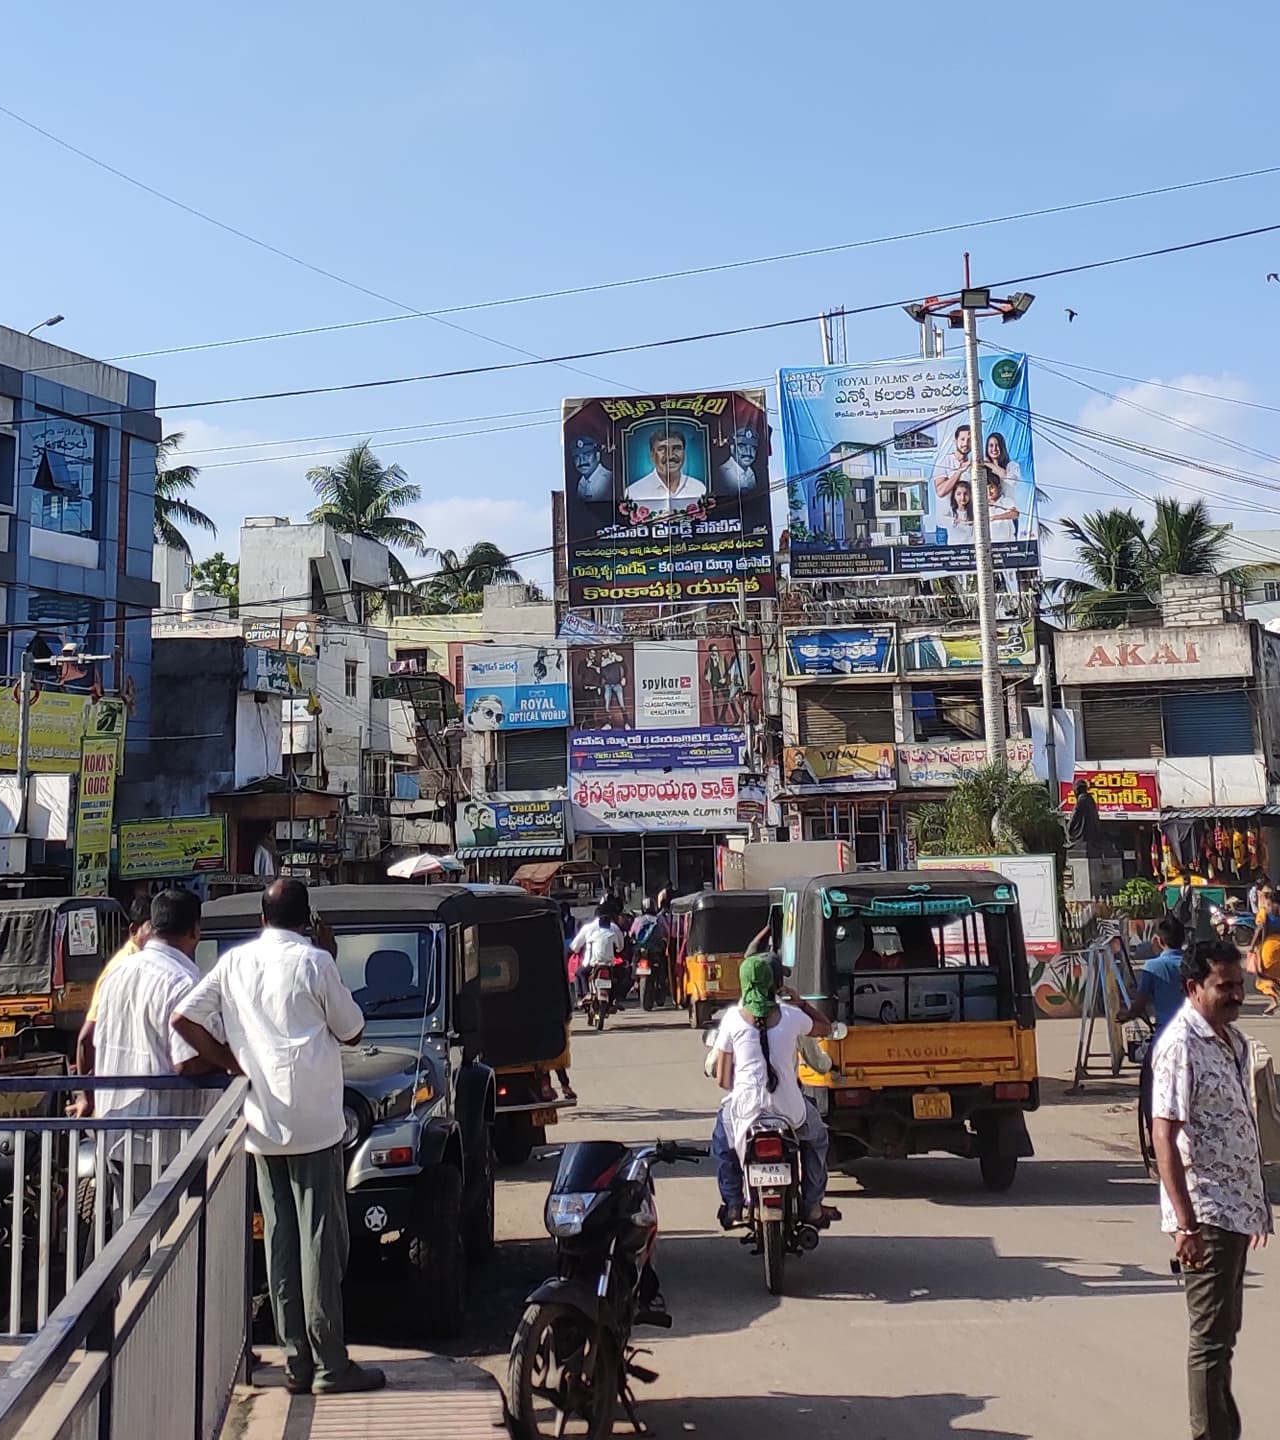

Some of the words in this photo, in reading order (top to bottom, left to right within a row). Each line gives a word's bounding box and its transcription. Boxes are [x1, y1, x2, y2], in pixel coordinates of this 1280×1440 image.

[835, 388, 871, 408] ఎన్నో
[875, 386, 916, 402] కలలకి
[1085, 641, 1201, 668] AKAI
[642, 676, 679, 690] spykar
[521, 697, 555, 710] ROYAL
[509, 712, 539, 722] OPTICAL
[541, 710, 567, 721] WORLD
[84, 753, 114, 773] KOKA'S
[83, 776, 110, 795] LODGE
[603, 811, 617, 820] SRI
[693, 808, 720, 817] CLOTH
[887, 1046, 948, 1058] PIAGGIO
